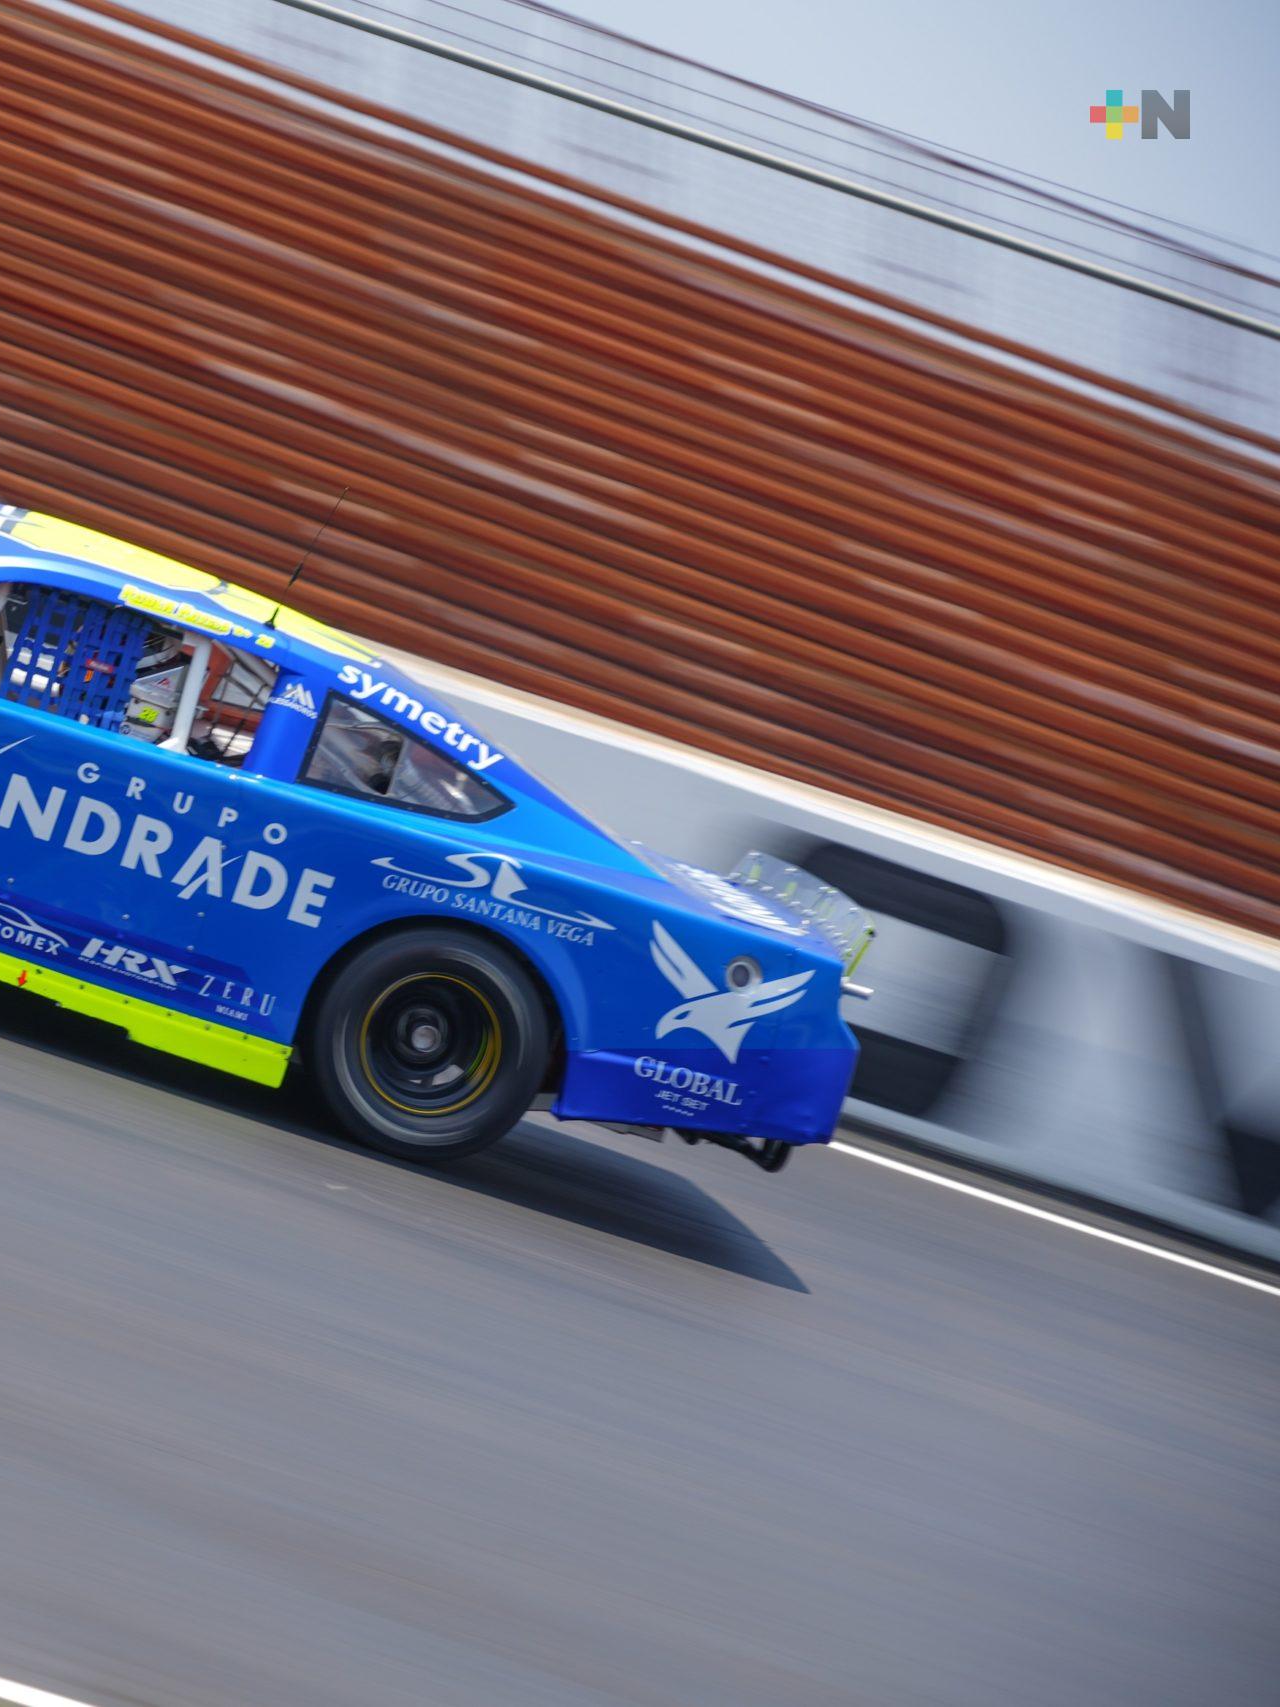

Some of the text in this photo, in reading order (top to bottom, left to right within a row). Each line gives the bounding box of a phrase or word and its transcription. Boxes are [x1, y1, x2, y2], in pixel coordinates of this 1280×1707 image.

[337, 665, 504, 770] symetry
[77, 762, 288, 845] GRUPO
[382, 873, 595, 947] GRUPO SANTANA VEGA
[80, 937, 190, 987] HRX
[197, 974, 277, 1017] ZERU
[634, 1055, 743, 1106] GLOBAL
[655, 1089, 682, 1103] JET
